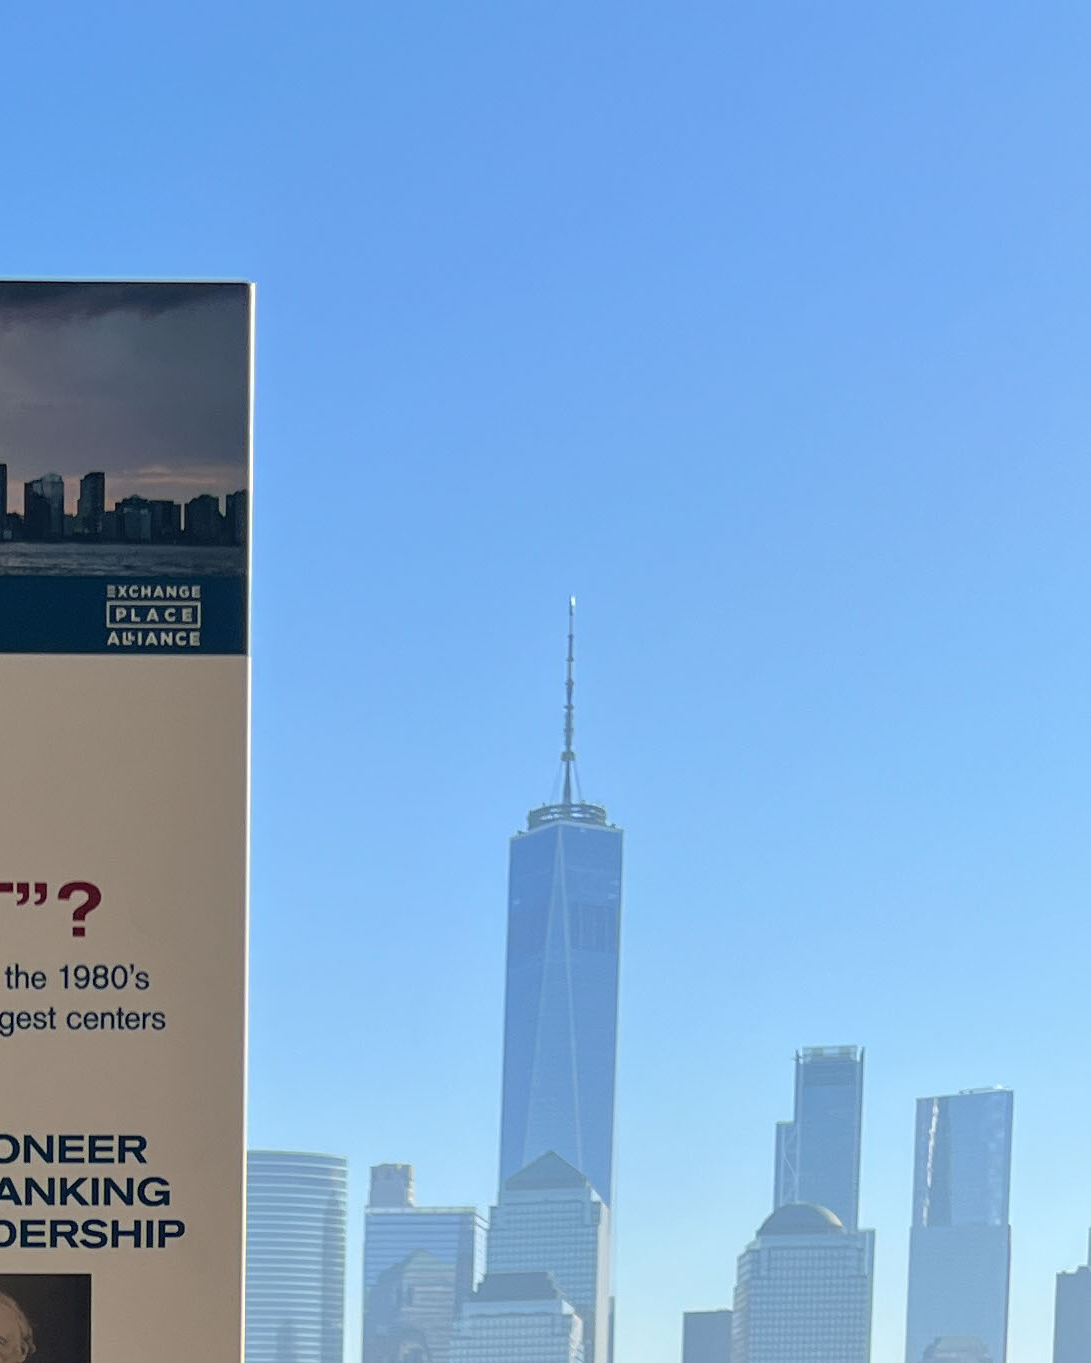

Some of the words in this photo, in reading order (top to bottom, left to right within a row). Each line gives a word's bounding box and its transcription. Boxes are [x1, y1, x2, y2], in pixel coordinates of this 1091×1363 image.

[107, 585, 200, 598] EXCHANGE
[116, 608, 192, 622] PLACE
[108, 632, 200, 646] ALLIANCE
[5, 964, 46, 989] the
[60, 964, 149, 990] 1980’s
[67, 1007, 166, 1030] centers
